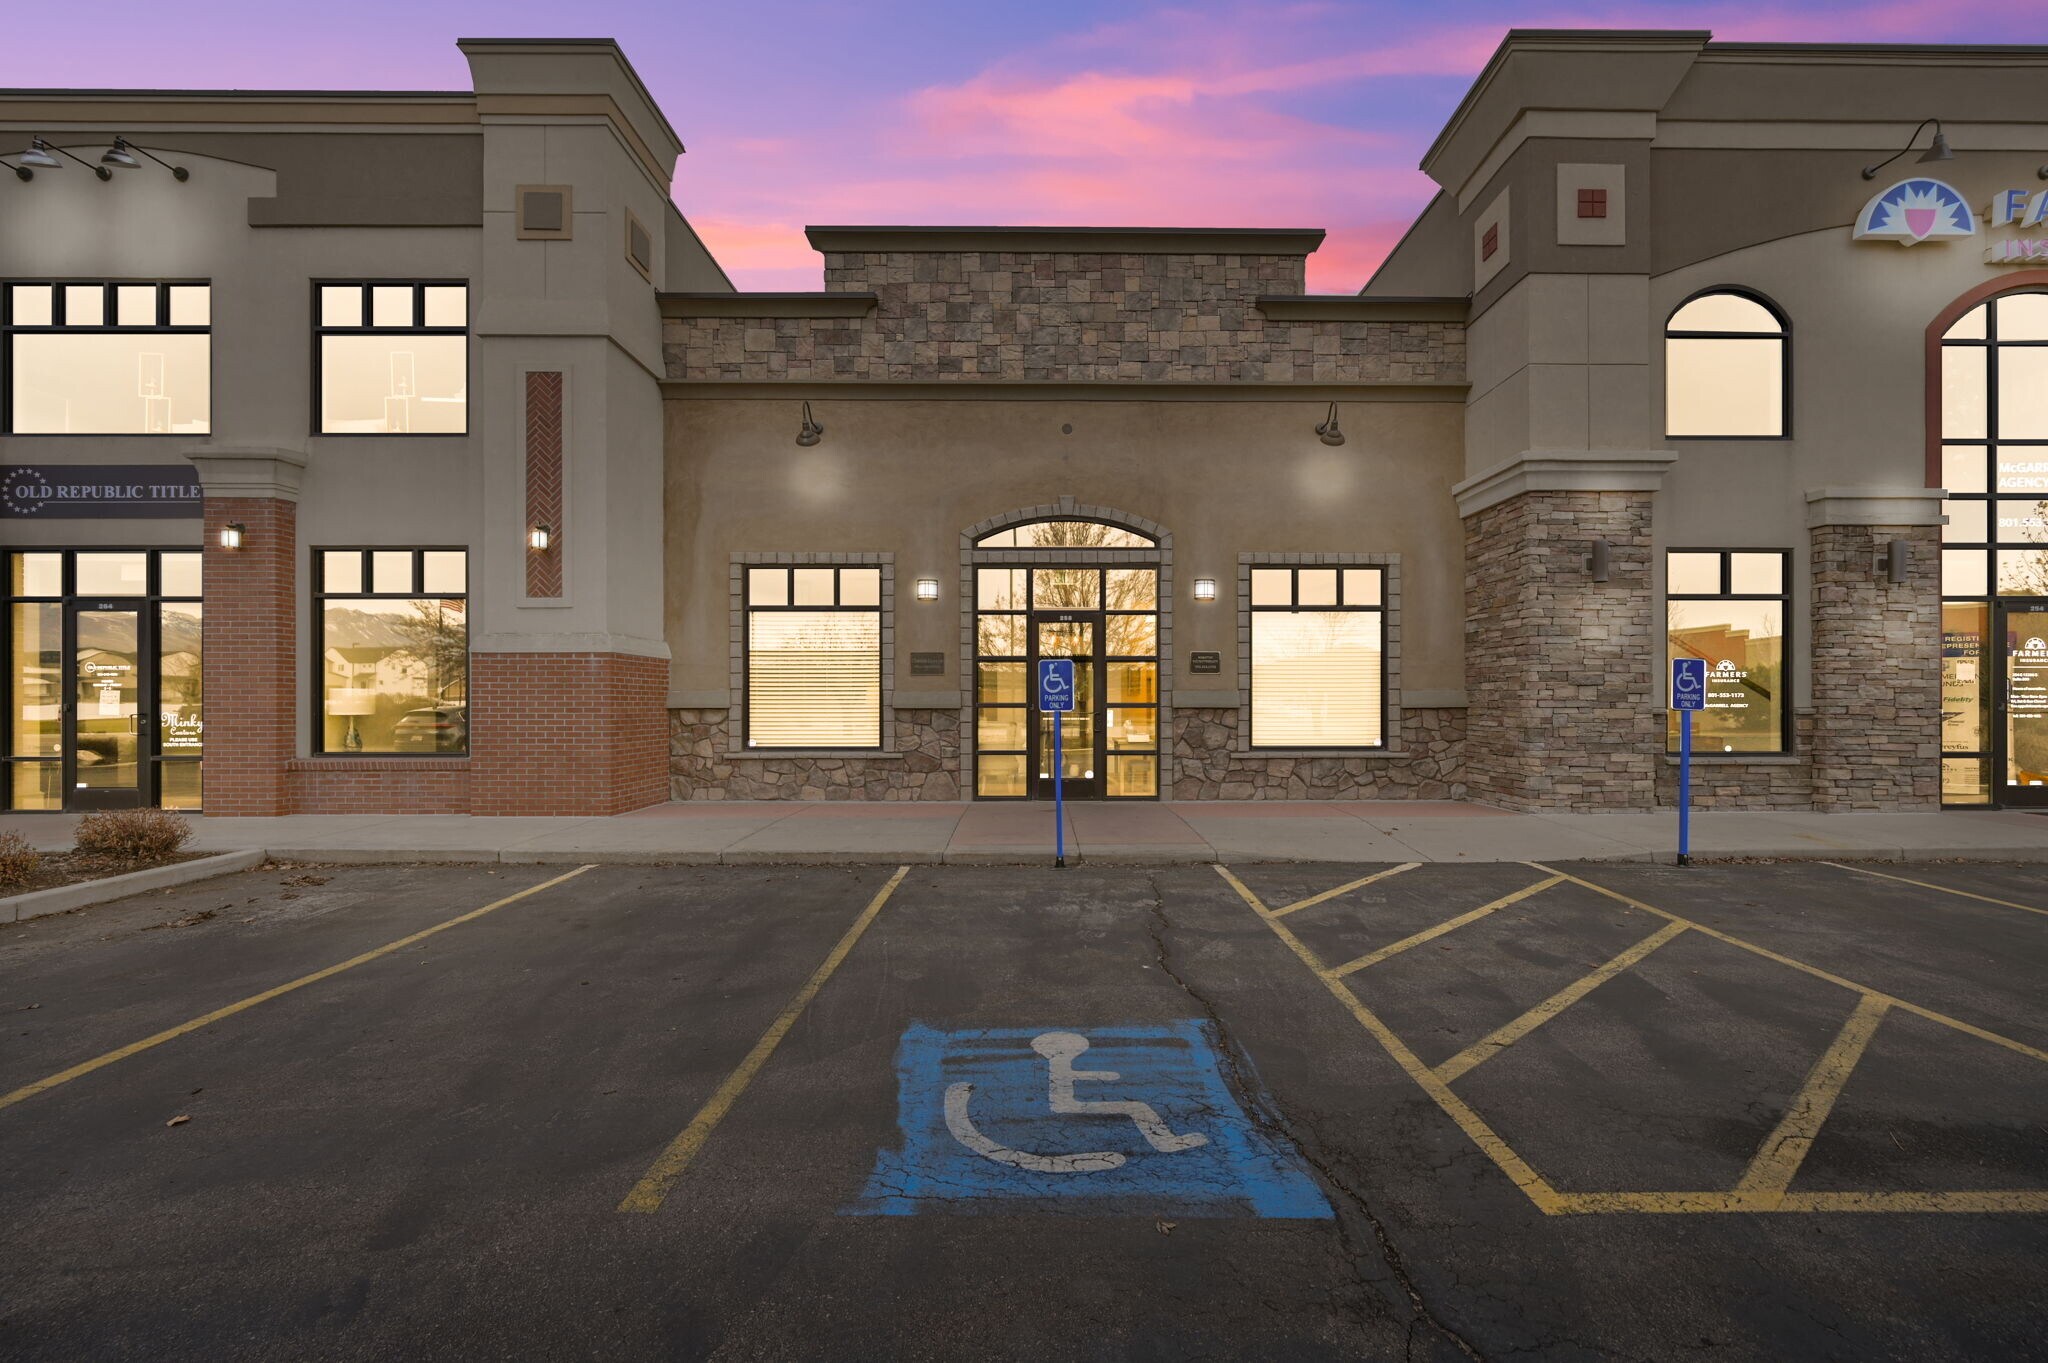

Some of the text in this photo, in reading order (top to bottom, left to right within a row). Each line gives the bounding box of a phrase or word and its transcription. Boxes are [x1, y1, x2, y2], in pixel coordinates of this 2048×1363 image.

[15, 485, 201, 499] OLD REPUBLIC TITLE
[1044, 694, 1069, 702] PARKING
[1676, 693, 1701, 701] PARKING
[1049, 701, 1065, 710] ONLY
[1680, 700, 1696, 708] ONLY
[161, 711, 203, 734] Minky
